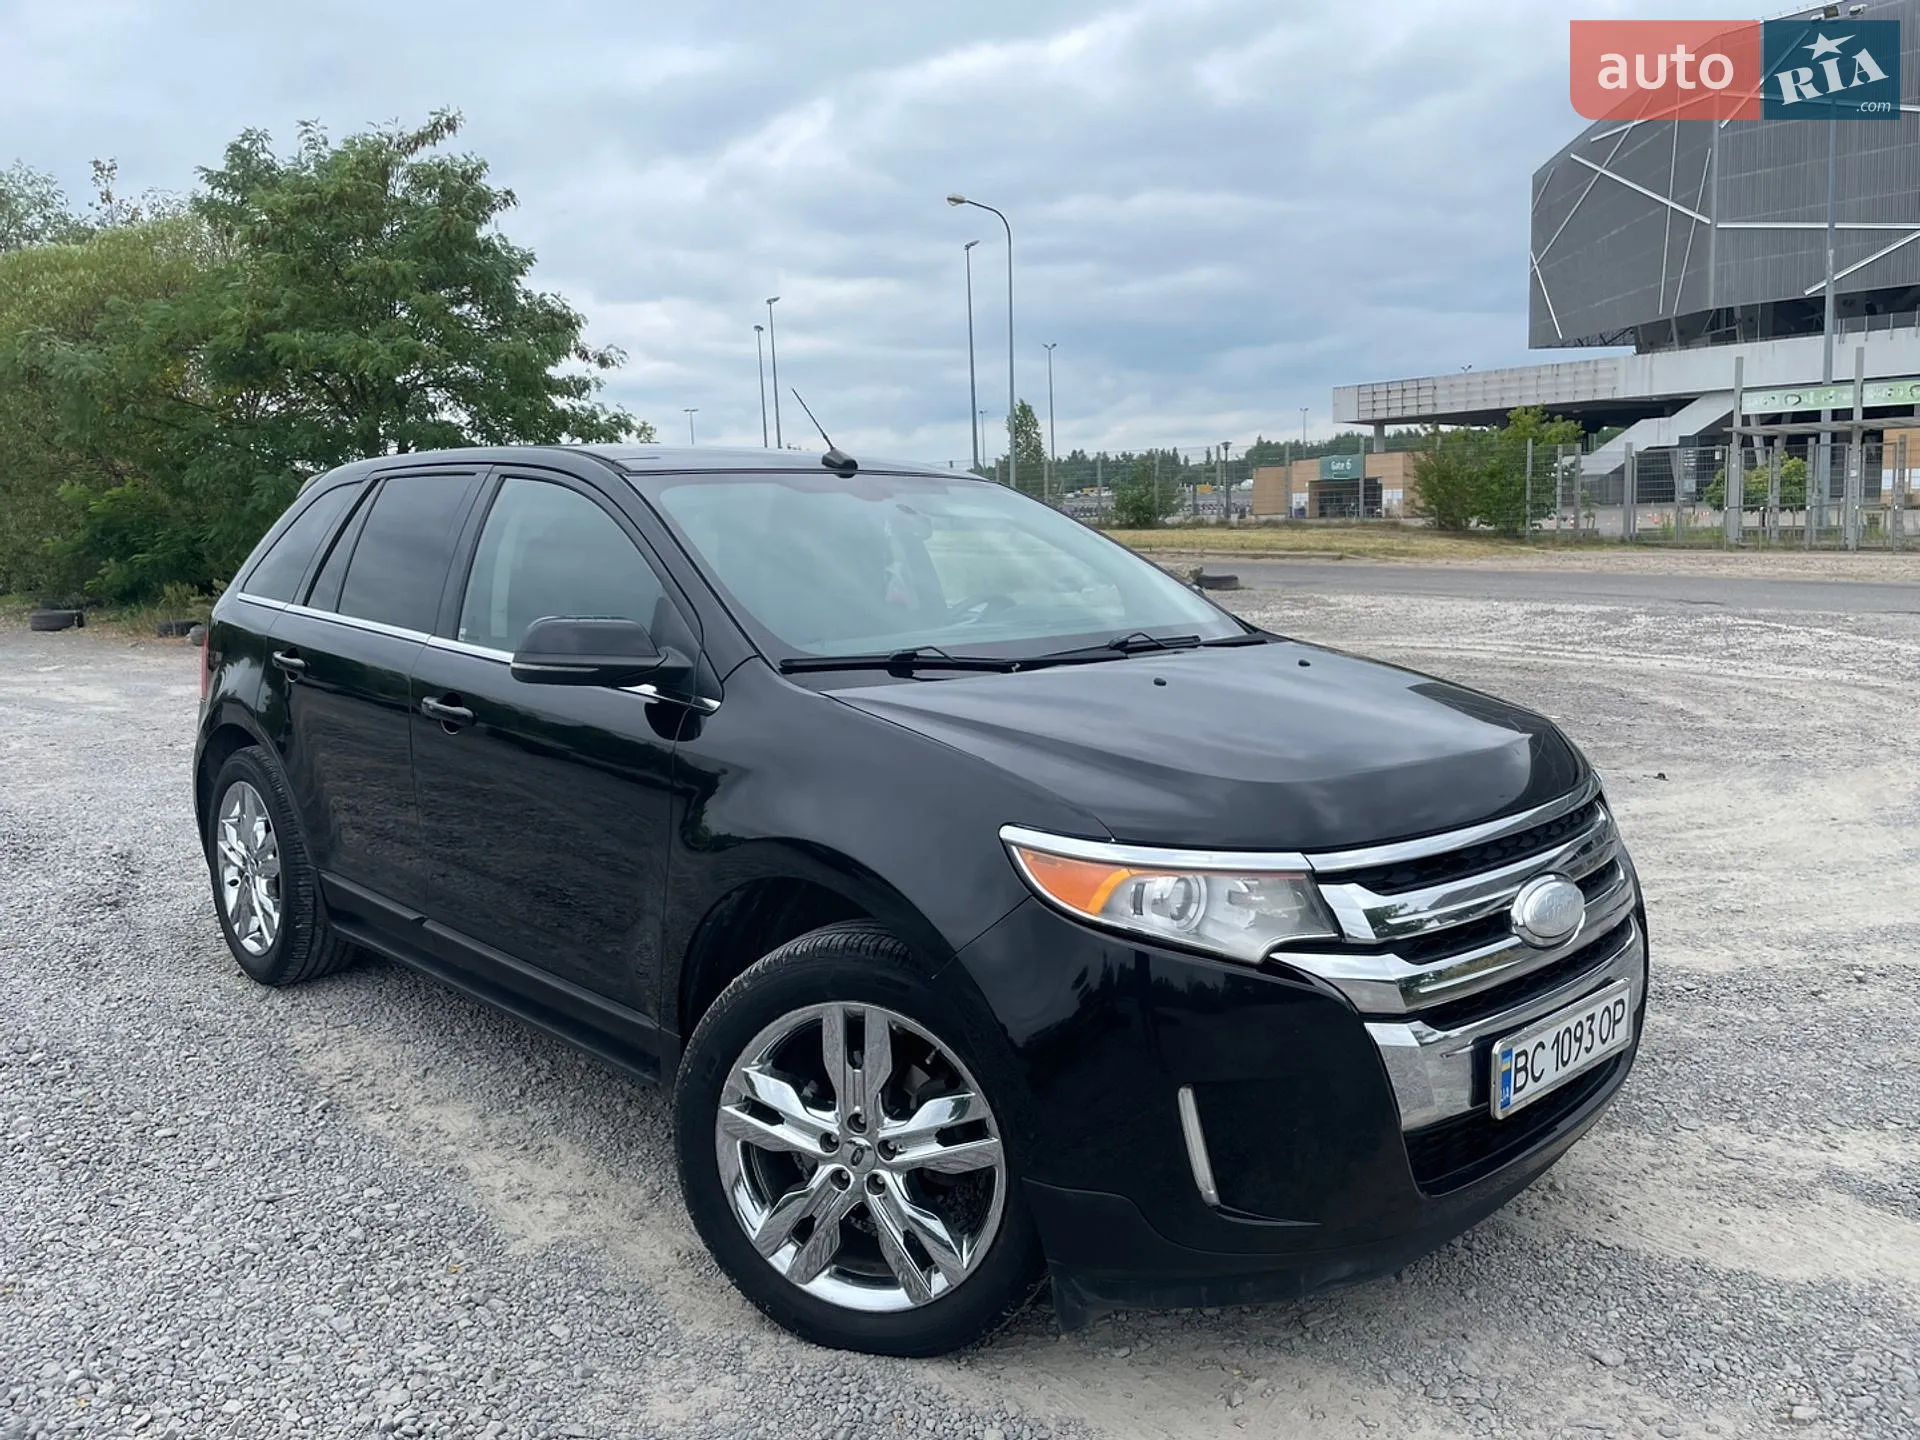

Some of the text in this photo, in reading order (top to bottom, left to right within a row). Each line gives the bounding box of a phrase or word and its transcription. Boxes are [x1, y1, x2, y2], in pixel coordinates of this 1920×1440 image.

[1512, 998, 1626, 1095] BC 1093 OP
